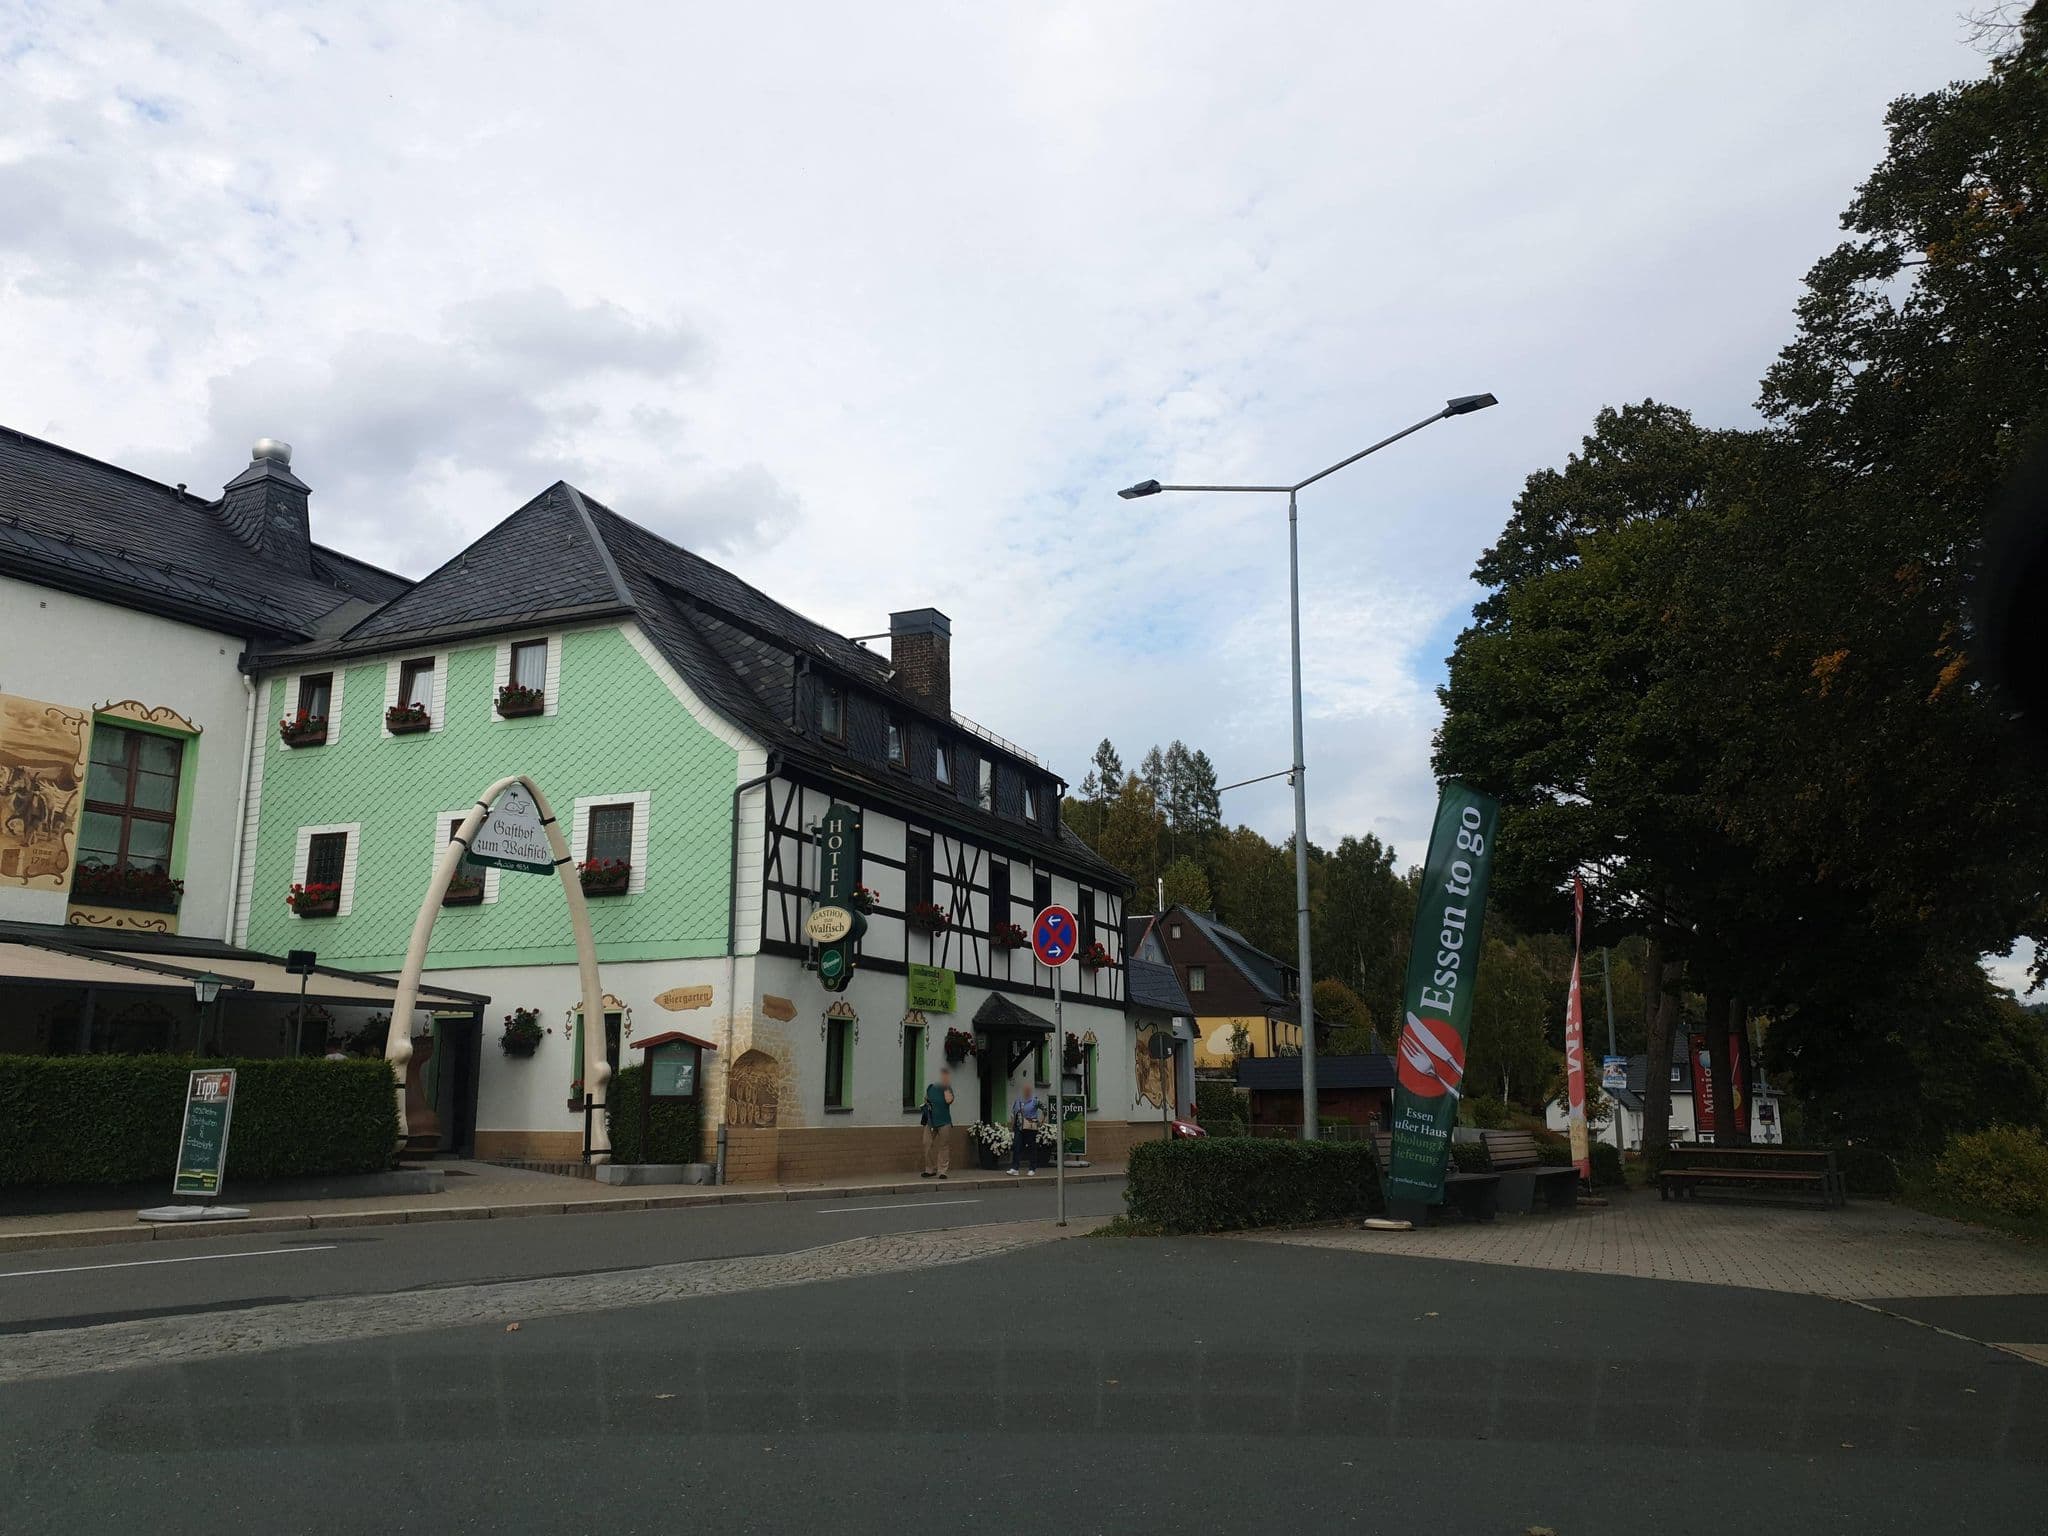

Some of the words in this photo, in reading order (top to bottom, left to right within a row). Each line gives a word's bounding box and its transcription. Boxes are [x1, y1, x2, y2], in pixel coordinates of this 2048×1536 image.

[1456, 806, 1485, 857] go
[478, 840, 498, 853] zum
[828, 819, 843, 898] HOTEL
[1445, 860, 1472, 897] to
[810, 922, 844, 934] Walfisch
[1420, 906, 1467, 1016] Essen
[663, 993, 709, 1004] Biergarten
[196, 1076, 218, 1100] Tipp
[1050, 1103, 1083, 1115] Kpfen
[1406, 1107, 1433, 1122] Essen
[1395, 1119, 1419, 1133] ußer
[1421, 1124, 1447, 1138] Haus
[1394, 1130, 1437, 1151] bholung
[1396, 1146, 1439, 1167] ieferung
